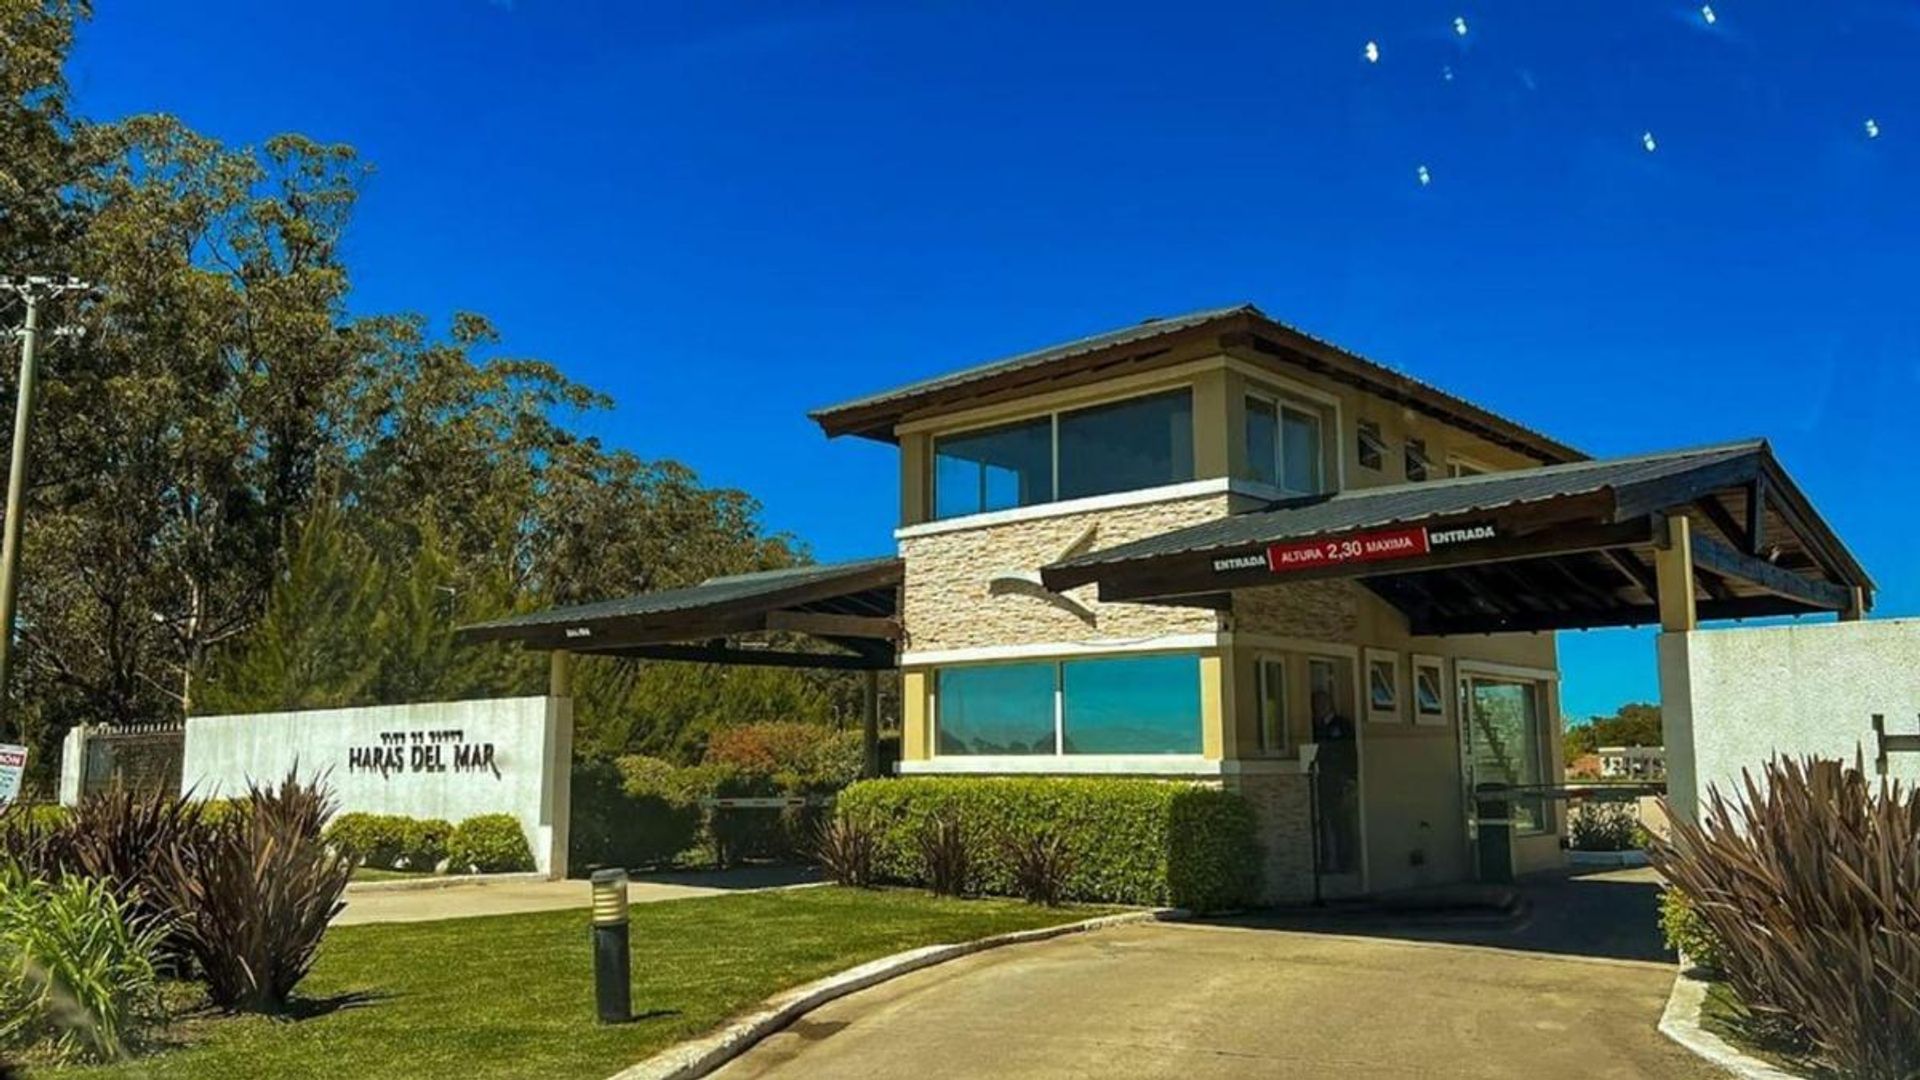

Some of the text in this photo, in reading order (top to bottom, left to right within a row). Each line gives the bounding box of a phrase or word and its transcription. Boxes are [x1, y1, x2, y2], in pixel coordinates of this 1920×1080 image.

[1213, 526, 1495, 571] ENTRADA ALTURA 2,30 MAXIMA ENTRADA
[349, 743, 502, 780] HARAS DEL MAR
